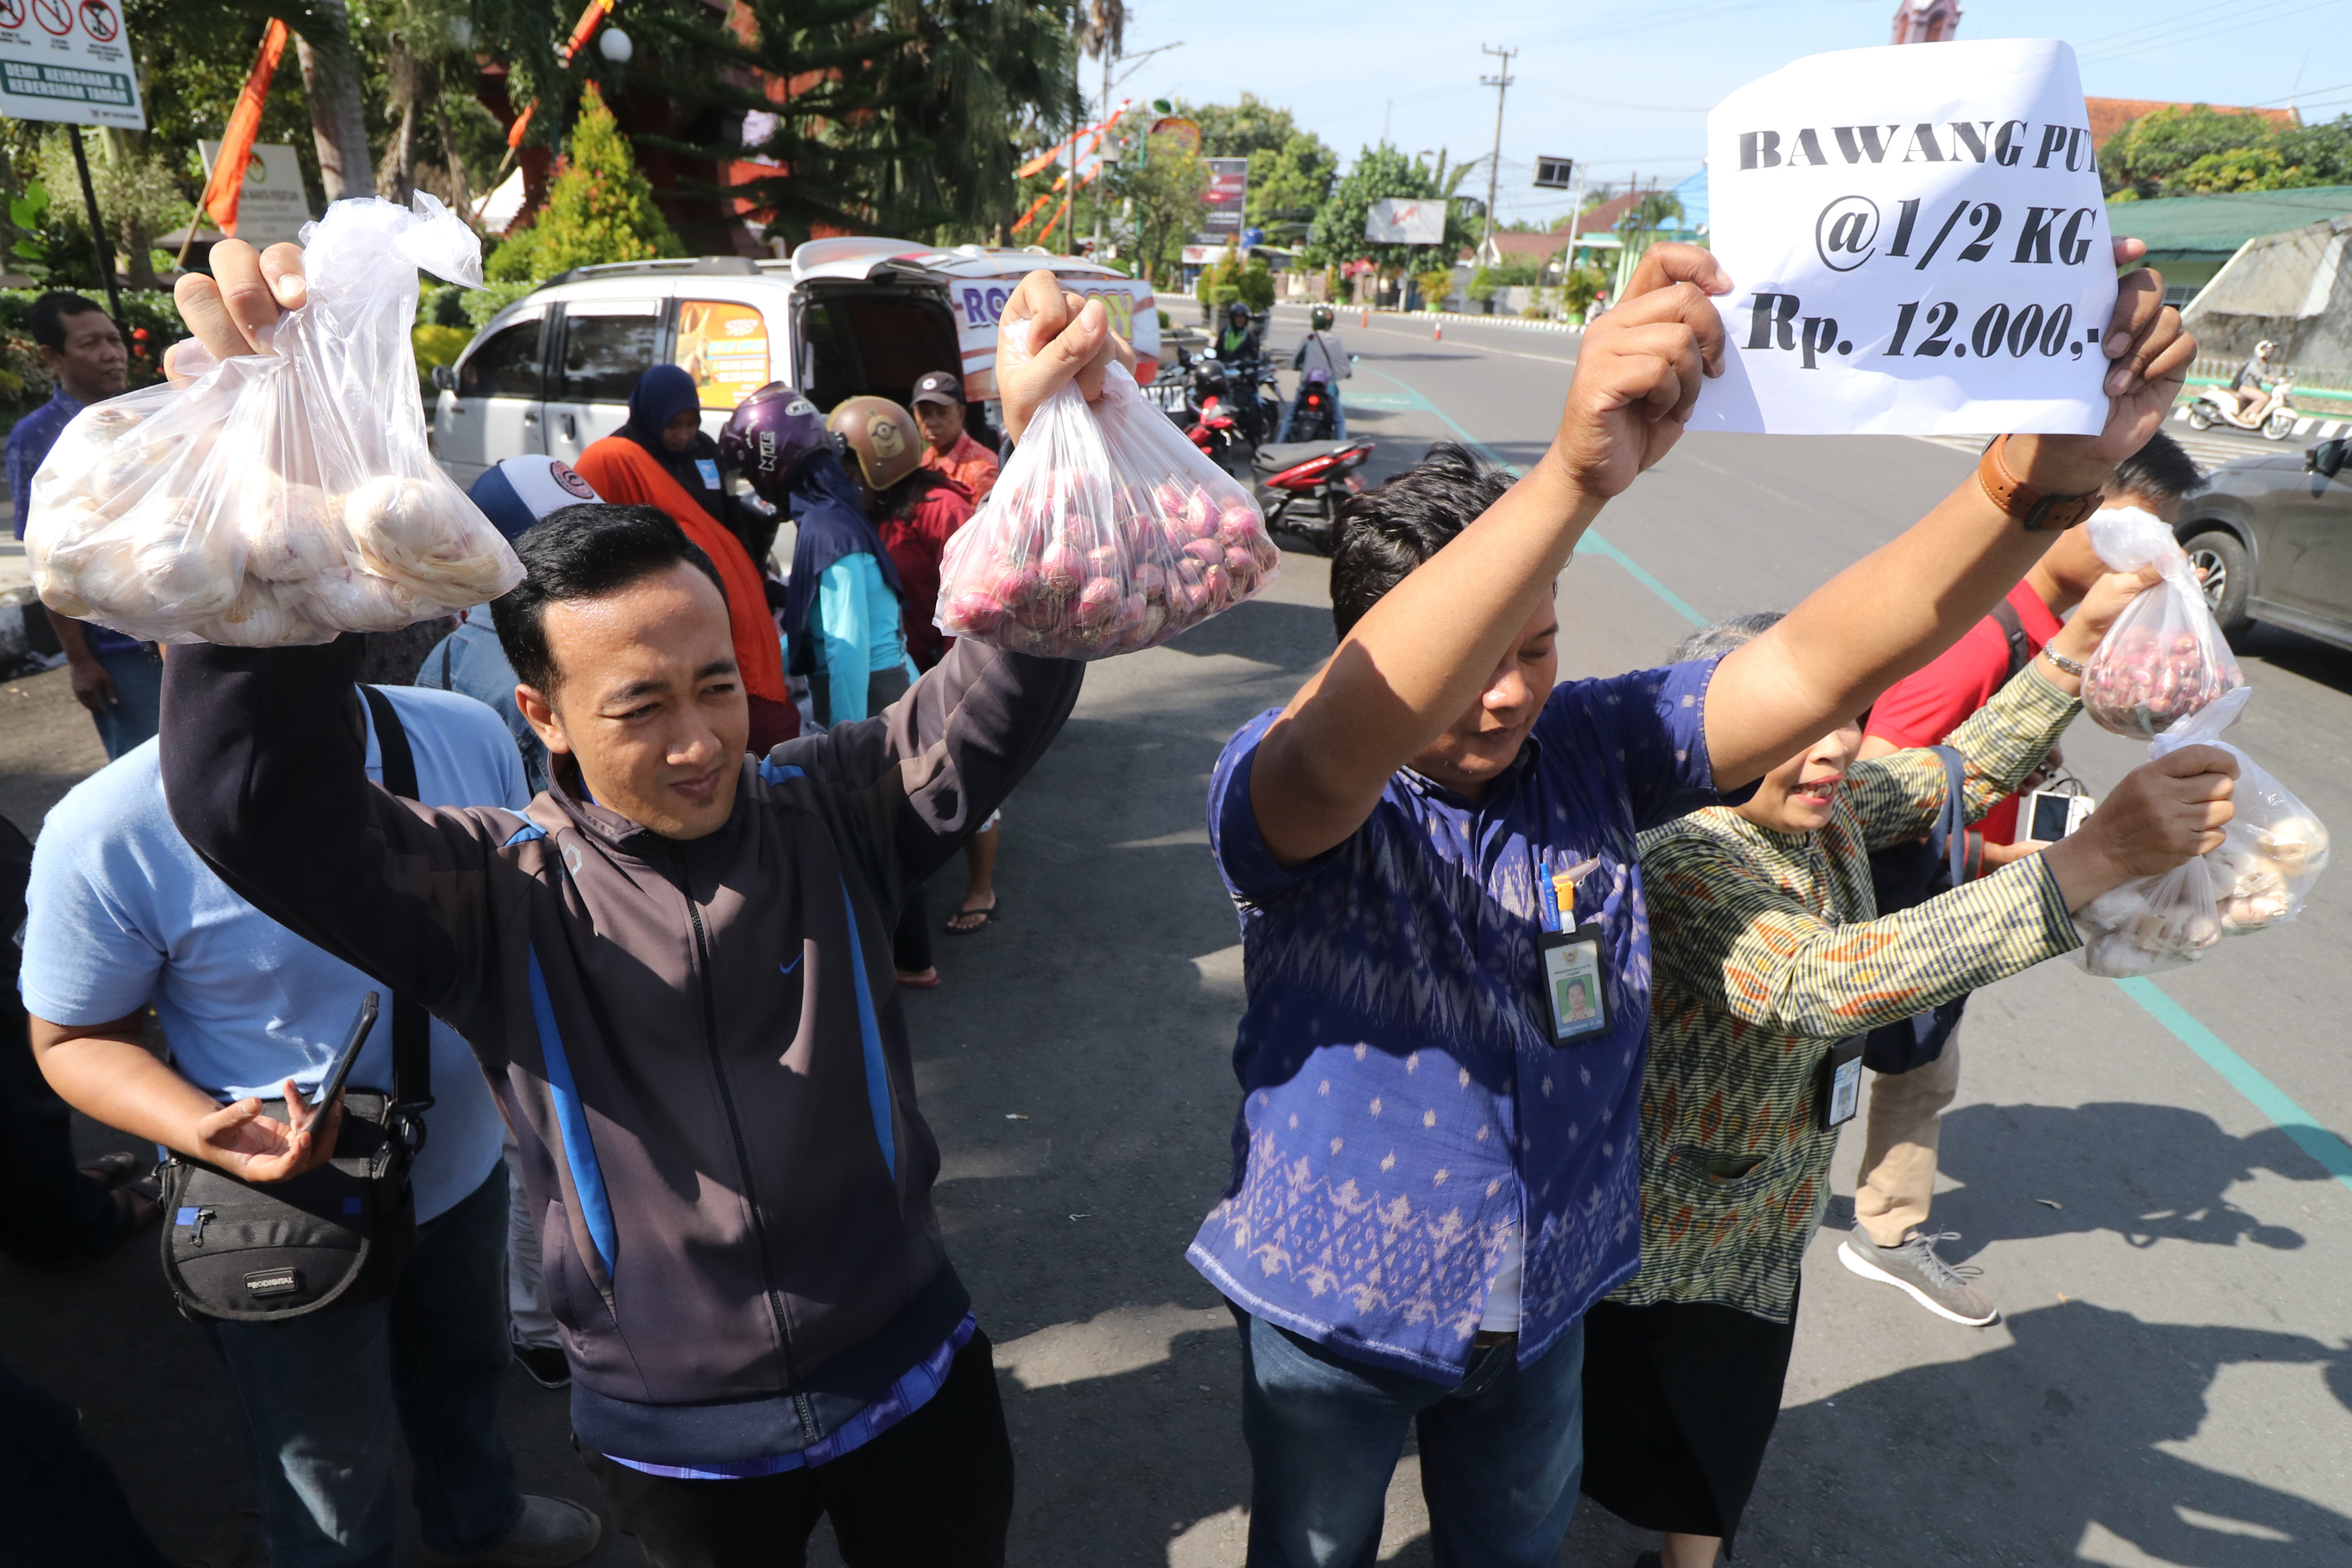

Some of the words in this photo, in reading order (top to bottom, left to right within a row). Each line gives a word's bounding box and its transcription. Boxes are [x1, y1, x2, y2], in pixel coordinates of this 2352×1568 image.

[1735, 120, 2029, 171] BAWANG
[1816, 196, 2002, 272] @1/2
[2010, 206, 2097, 266] KG
[1741, 293, 1853, 369] Rp.
[1882, 300, 2099, 361] 12.000,-
[247, 1276, 294, 1289] PRODIGITAL
